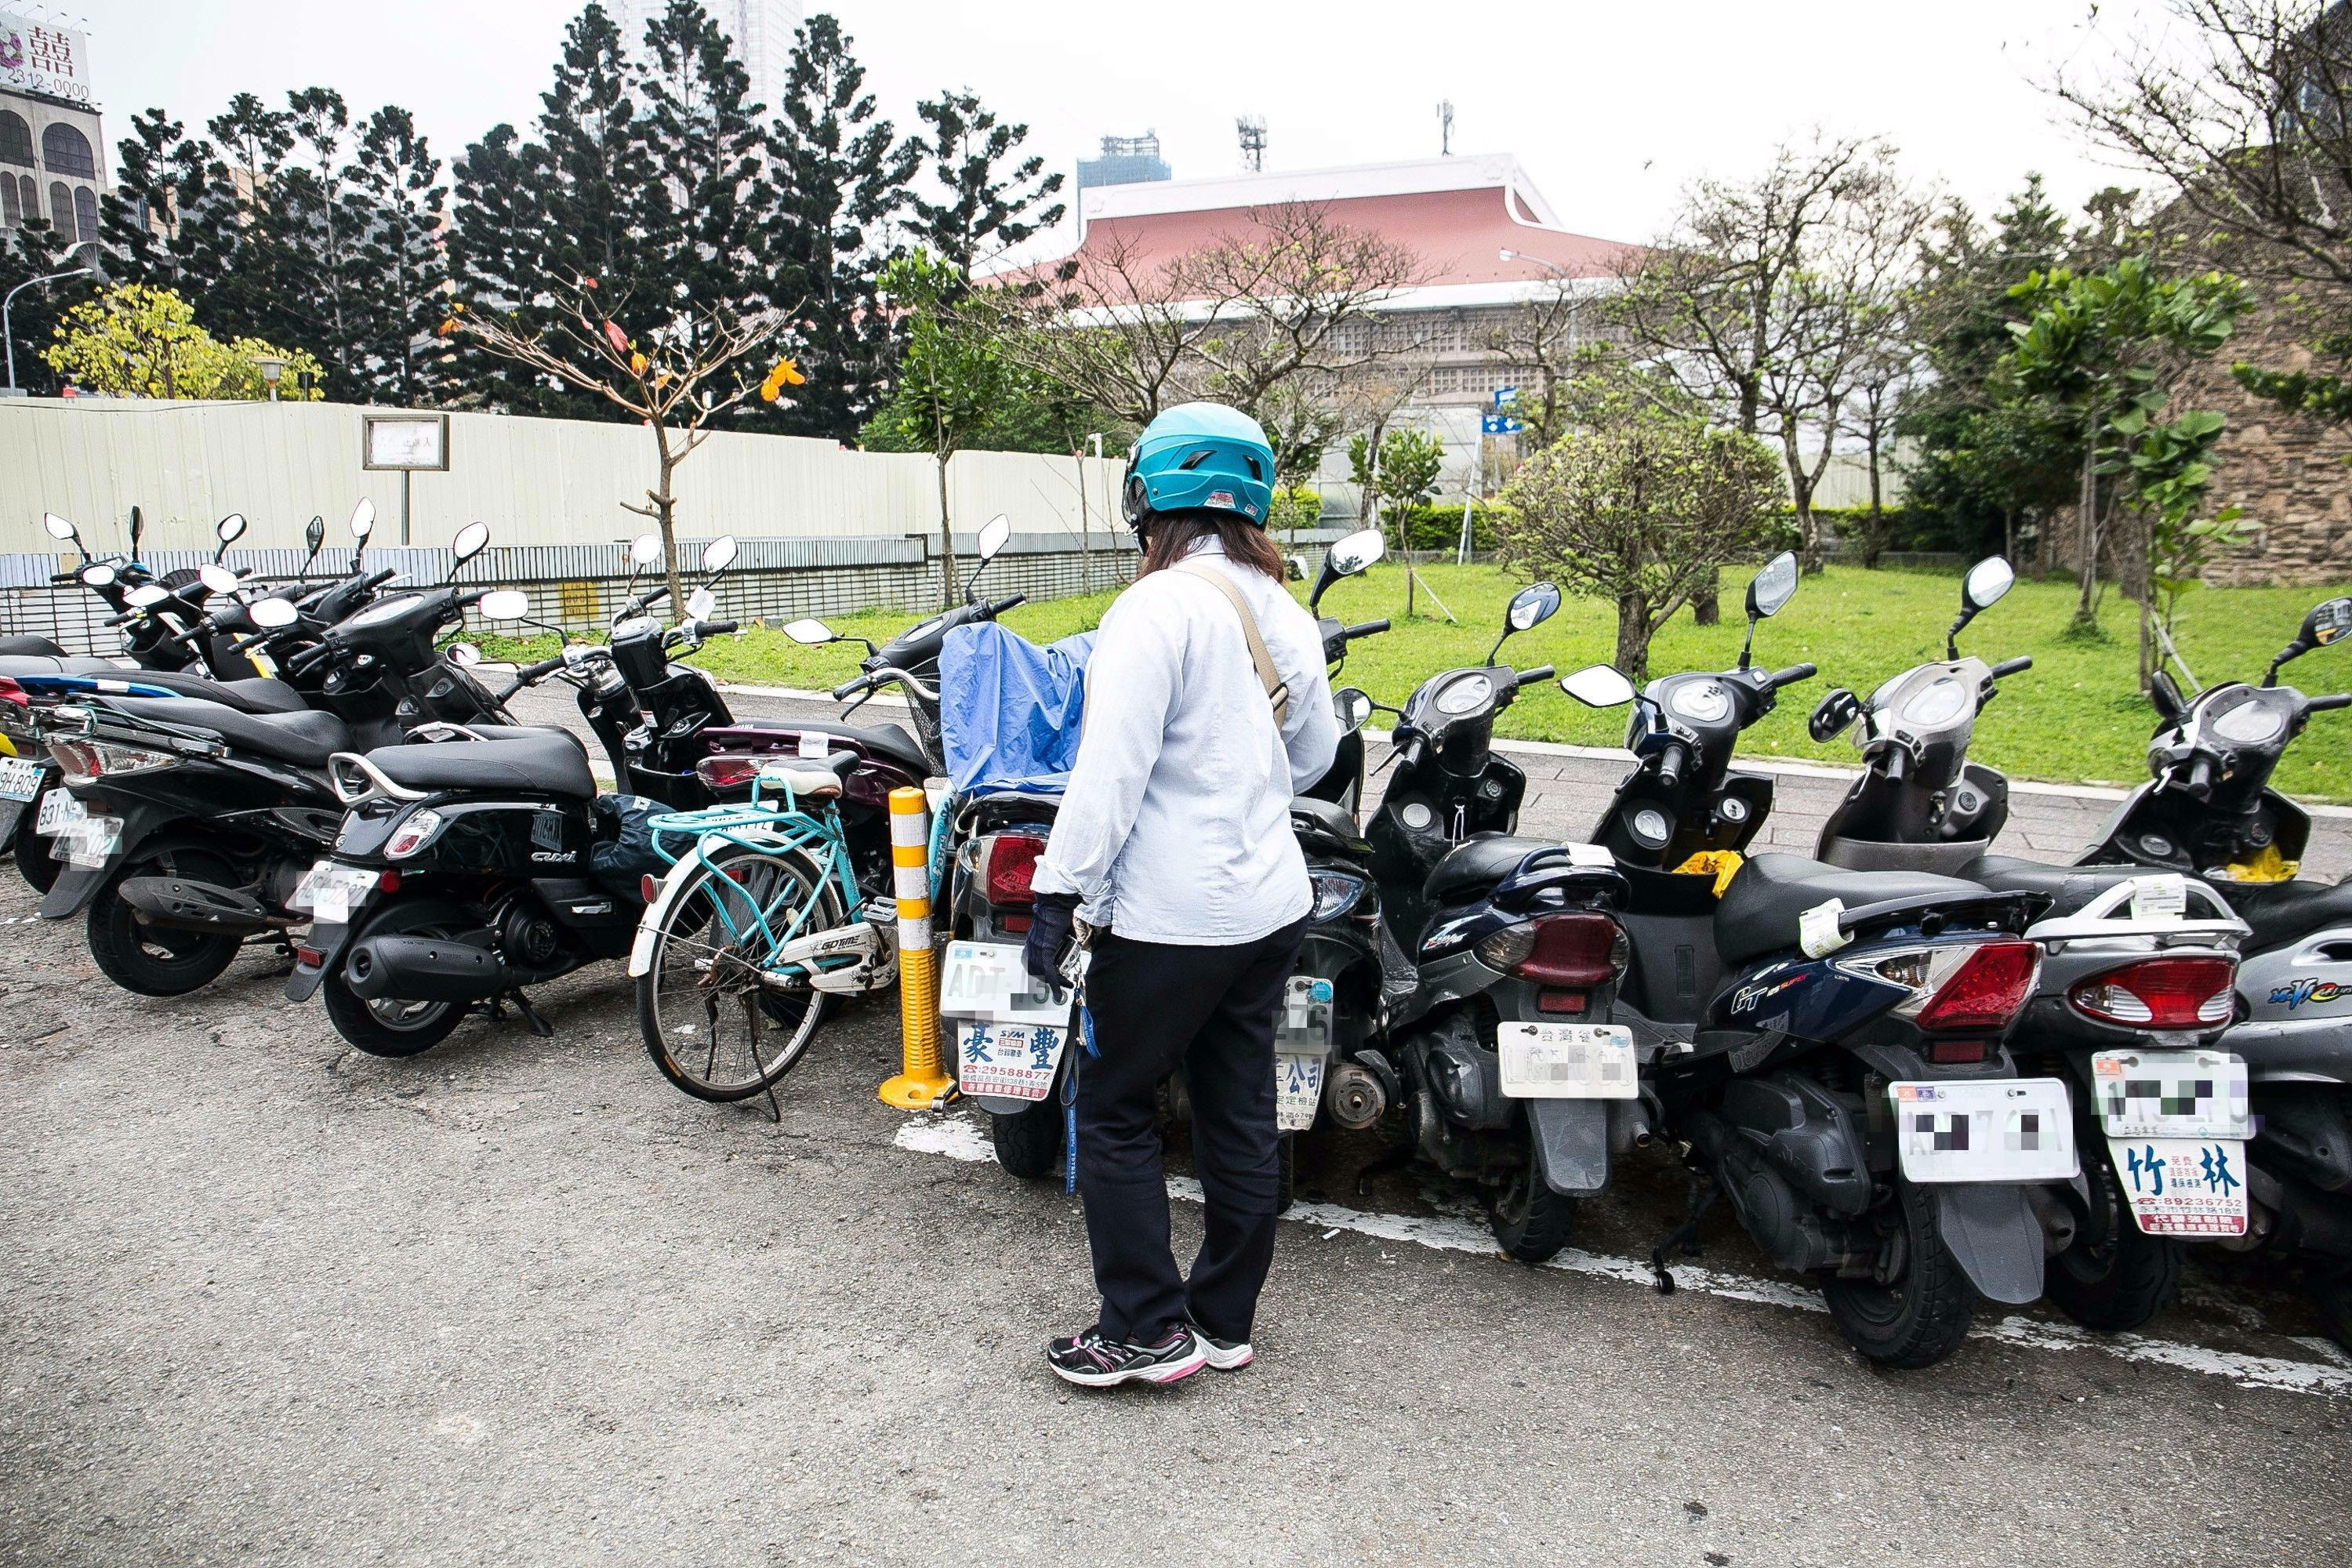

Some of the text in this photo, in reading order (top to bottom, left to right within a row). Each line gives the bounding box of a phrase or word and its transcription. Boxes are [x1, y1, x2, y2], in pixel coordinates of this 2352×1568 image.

[9, 67, 89, 98] 2312-0000
[964, 1022, 994, 1063] 豪
[1000, 1030, 1025, 1039] SYM
[2127, 1143, 2241, 1197] 竹 林
